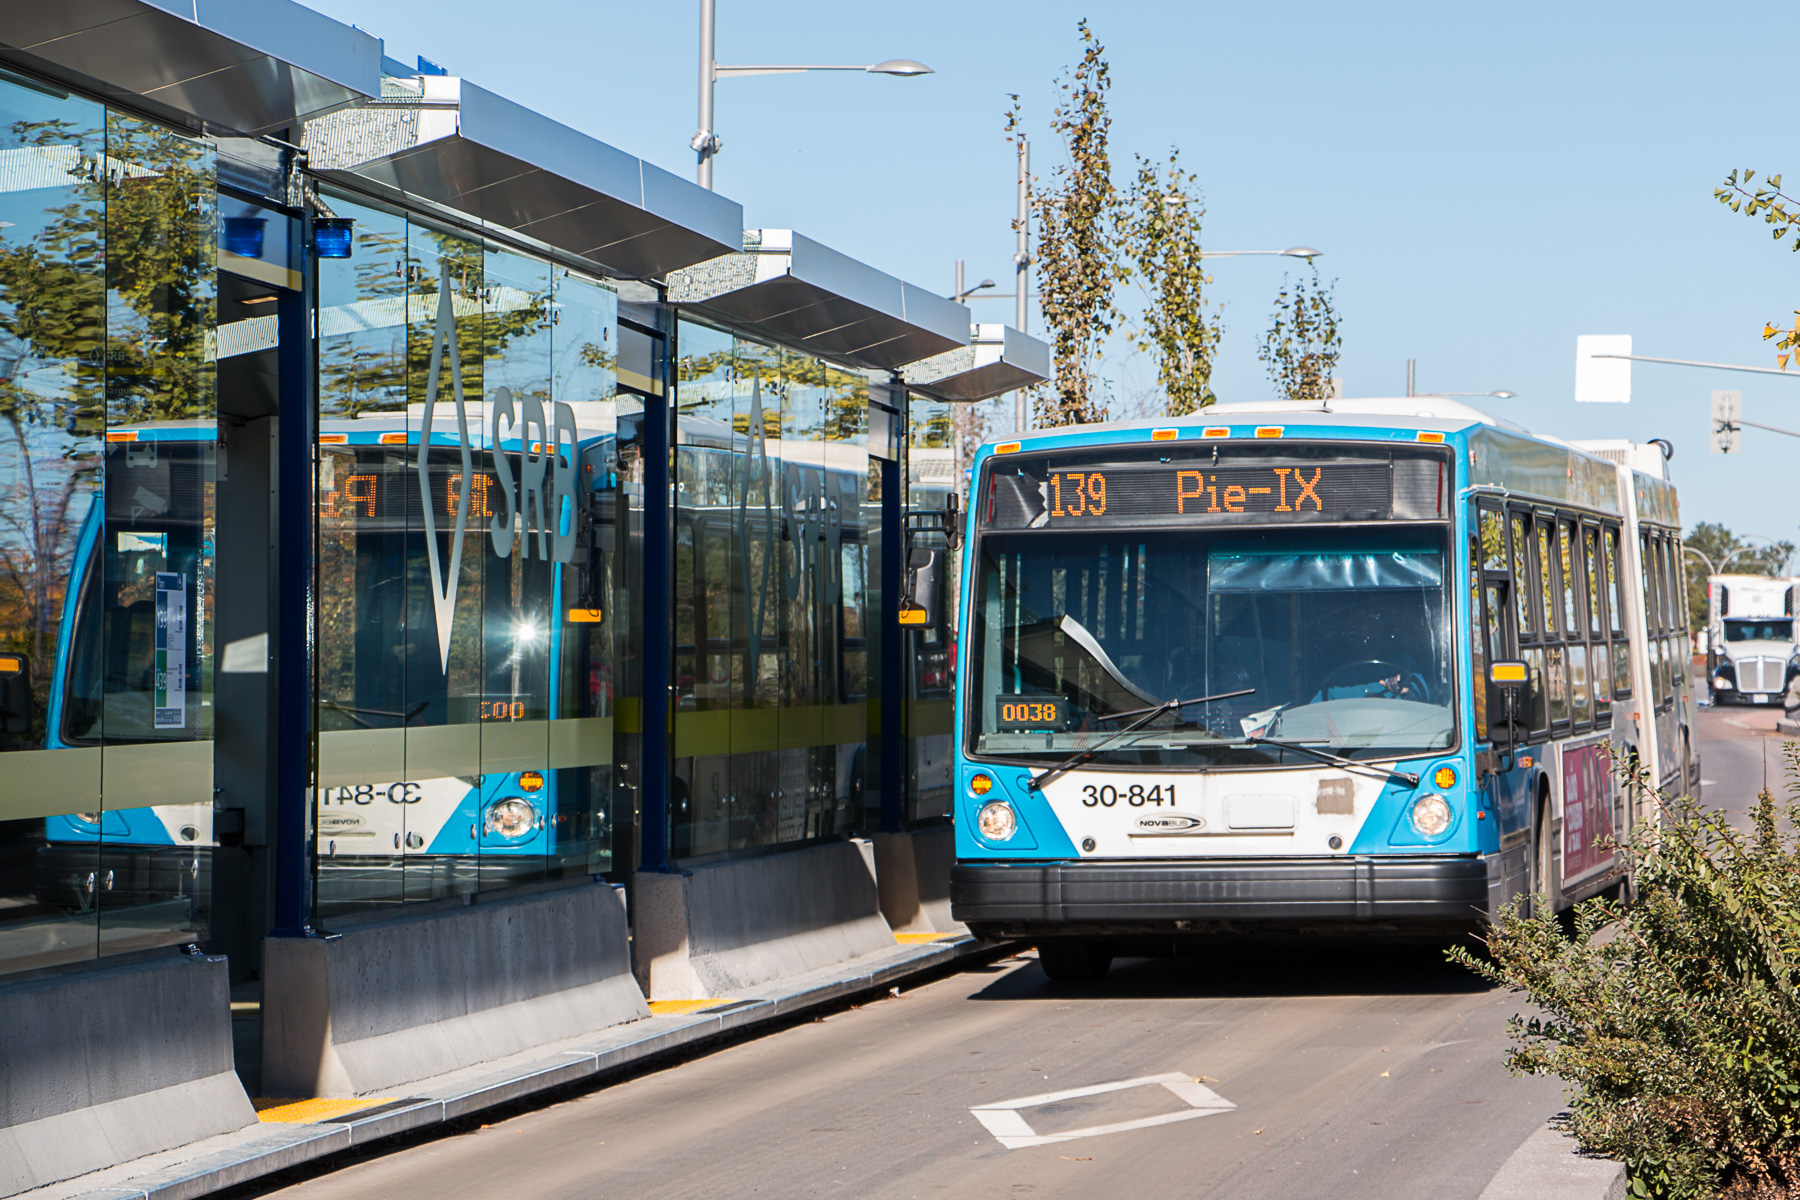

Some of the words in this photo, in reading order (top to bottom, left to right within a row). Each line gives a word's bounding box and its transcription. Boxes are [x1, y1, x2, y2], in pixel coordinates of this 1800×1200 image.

[490, 385, 578, 564] SRB
[1050, 473, 1106, 516] 139
[1177, 467, 1322, 514] Pie-IX
[784, 462, 842, 605] SRB
[1003, 704, 1056, 721] 0038
[1082, 784, 1176, 807] 30-841
